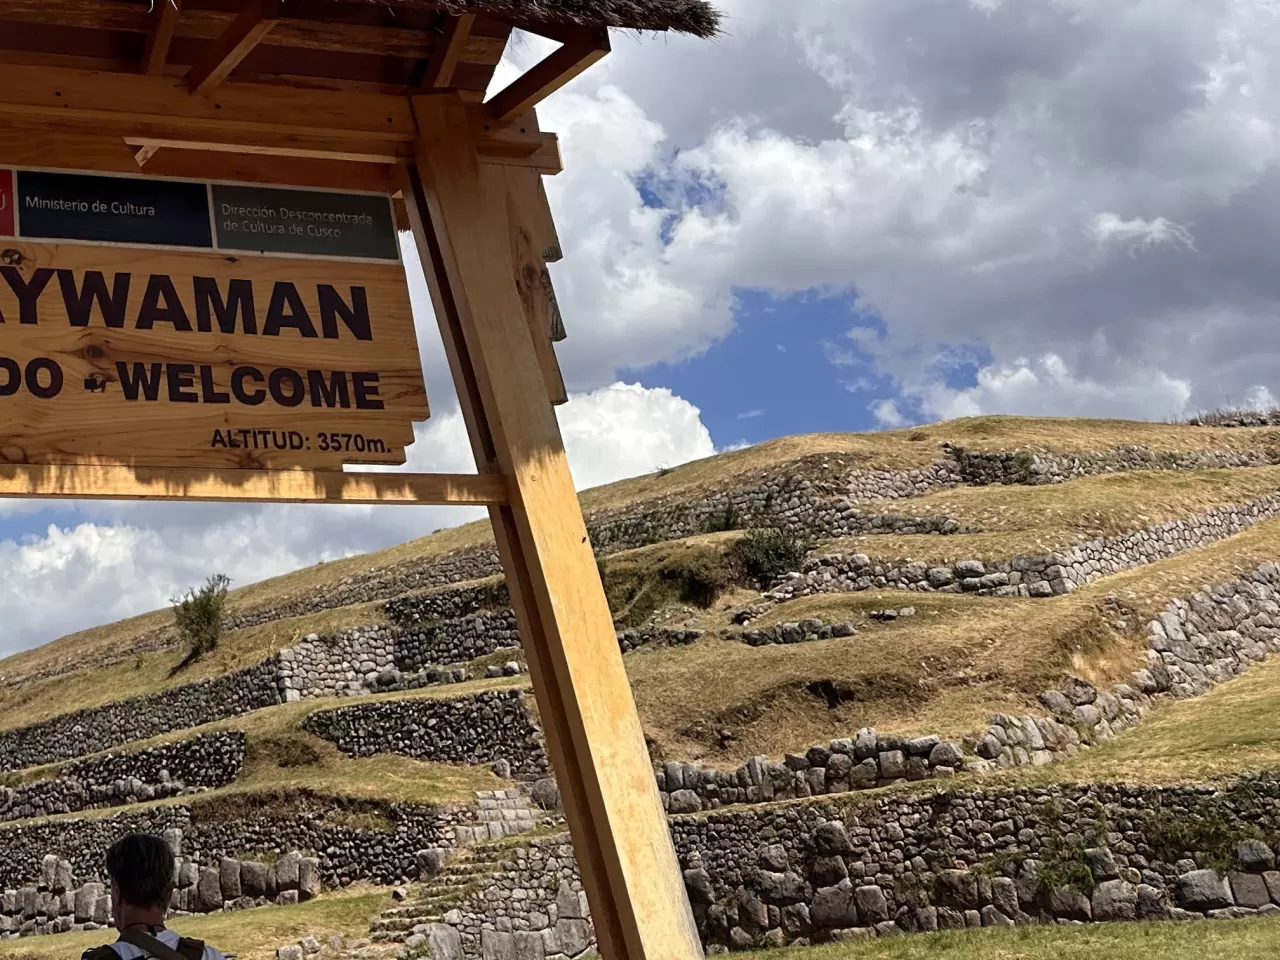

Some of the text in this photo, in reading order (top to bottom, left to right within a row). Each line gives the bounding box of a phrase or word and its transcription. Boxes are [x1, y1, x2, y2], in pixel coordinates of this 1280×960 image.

[25, 196, 156, 216] Ministerio de Cultura
[221, 203, 373, 224] Dirección Desconcentrada
[223, 219, 342, 238] de Cultura de Cusco
[115, 360, 385, 411] WELCOME
[210, 428, 392, 454] ALTITUD: 3570m.
